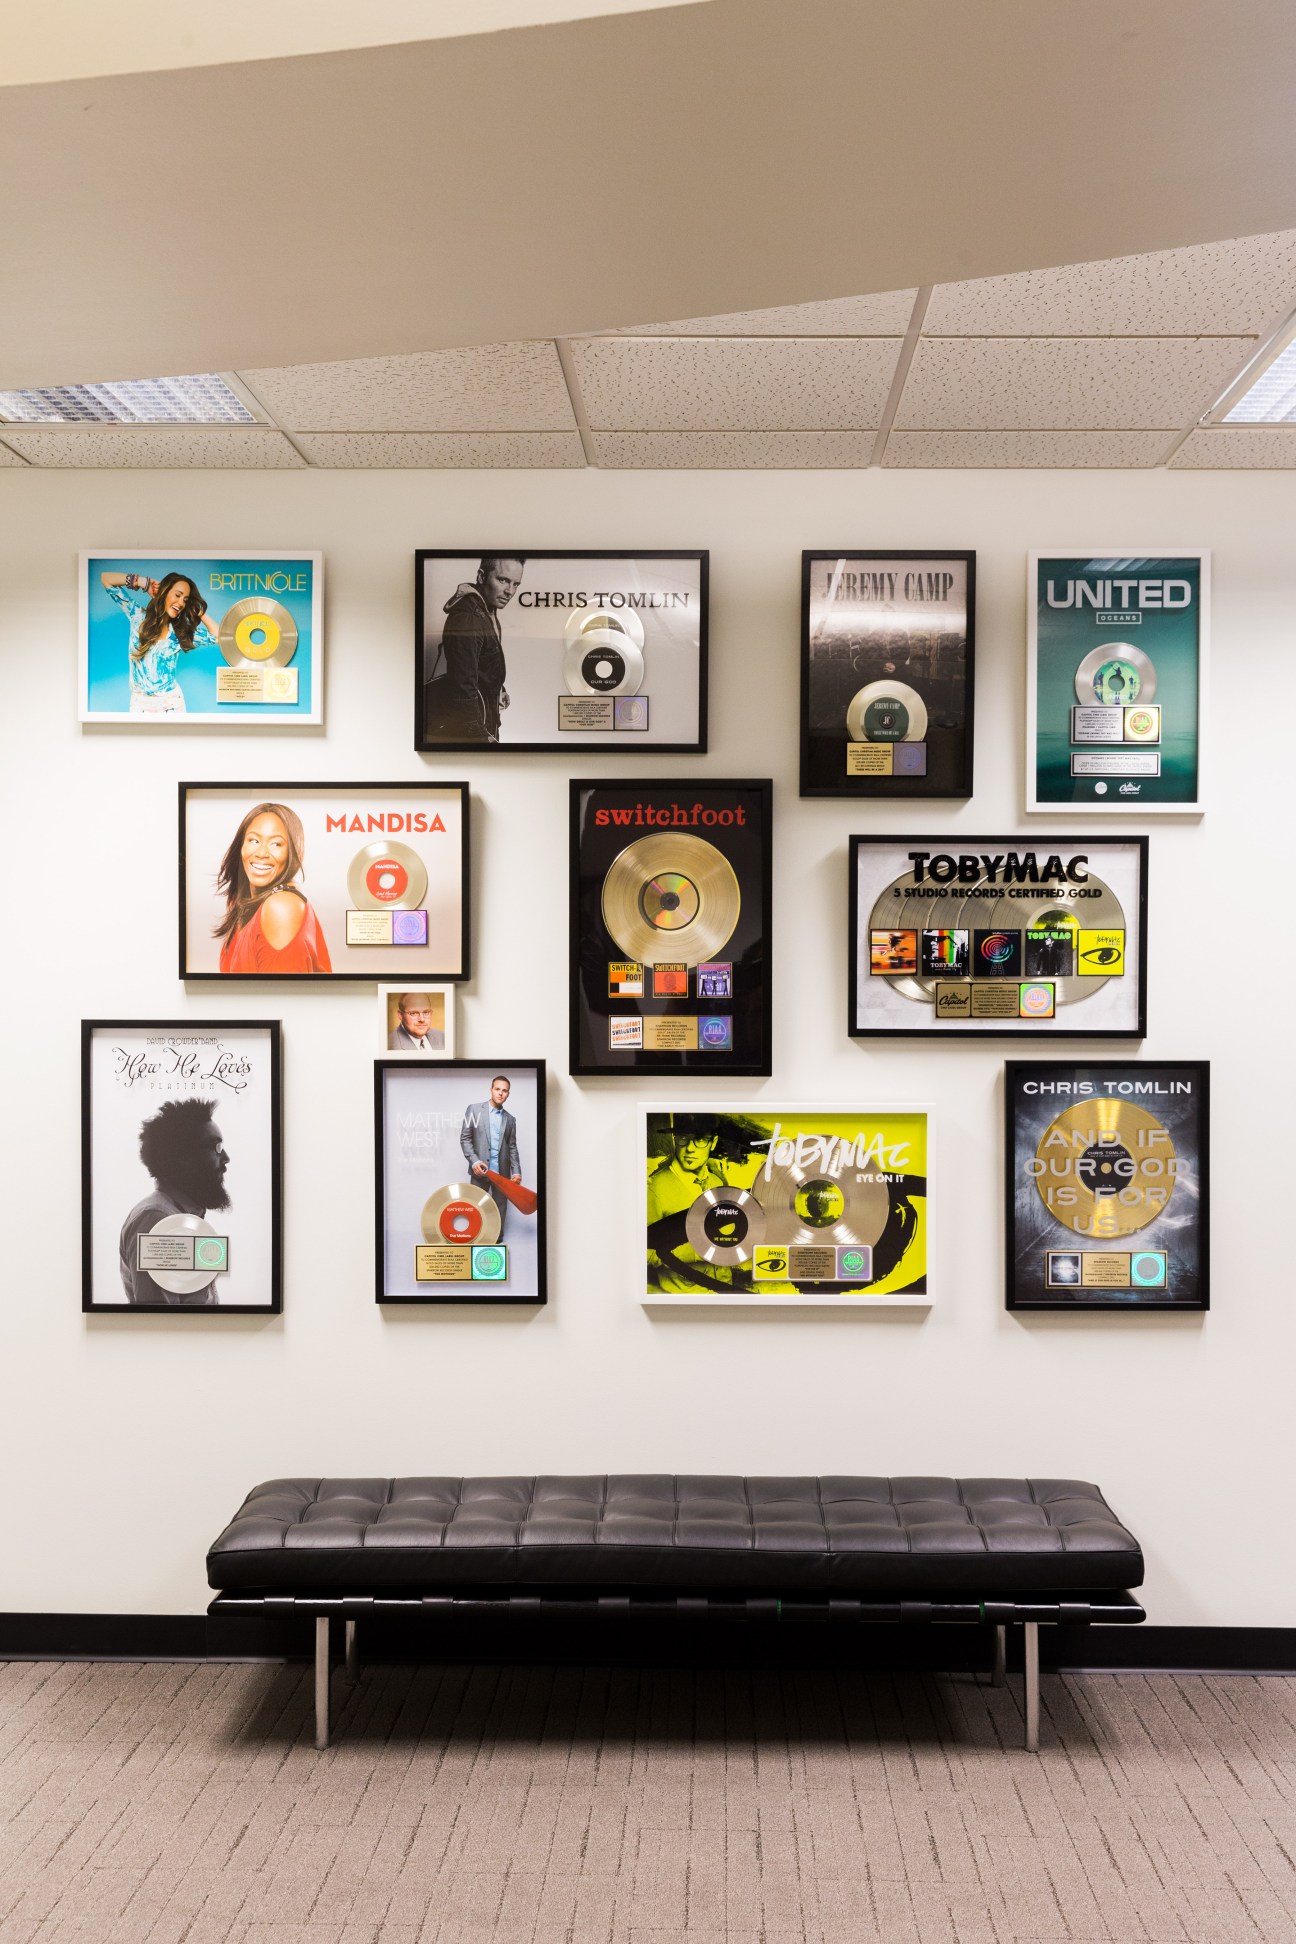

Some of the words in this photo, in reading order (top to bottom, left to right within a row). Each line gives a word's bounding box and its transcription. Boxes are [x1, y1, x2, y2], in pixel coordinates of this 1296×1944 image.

[823, 572, 899, 601] JEREMY
[904, 572, 954, 601] CAMP
[1046, 579, 1192, 609] UNITED
[518, 592, 588, 608] CHRIS
[593, 592, 690, 608] TOMLIN
[326, 813, 447, 833] MANDISA
[595, 804, 746, 826] switchfoot
[908, 852, 1089, 884] TOBYMAC
[894, 888, 901, 898] 5
[904, 888, 948, 898] STUDIO
[951, 888, 1005, 898] RECORDS
[1008, 888, 1065, 898] CERTIFIED
[1068, 888, 1103, 898] GOLD
[939, 994, 969, 1007] Capitol
[111, 1047, 162, 1087] How
[163, 1047, 200, 1077] He
[200, 1044, 253, 1094] Loves
[150, 1082, 215, 1090] PLATINUM
[1023, 1081, 1093, 1095] CHRIS
[1103, 1081, 1192, 1094] TOMLIN
[396, 1111, 482, 1129] MATTHEW
[398, 1131, 441, 1148] WEST
[1044, 1129, 1121, 1148] AND
[1138, 1129, 1170, 1148] IF
[1023, 1158, 1097, 1177] OUR
[1113, 1158, 1191, 1177] GOD
[856, 1174, 874, 1183] EYE
[877, 1174, 892, 1183] ON
[895, 1174, 905, 1183] IT
[1047, 1187, 1078, 1206] IS
[1095, 1187, 1168, 1206] FOR
